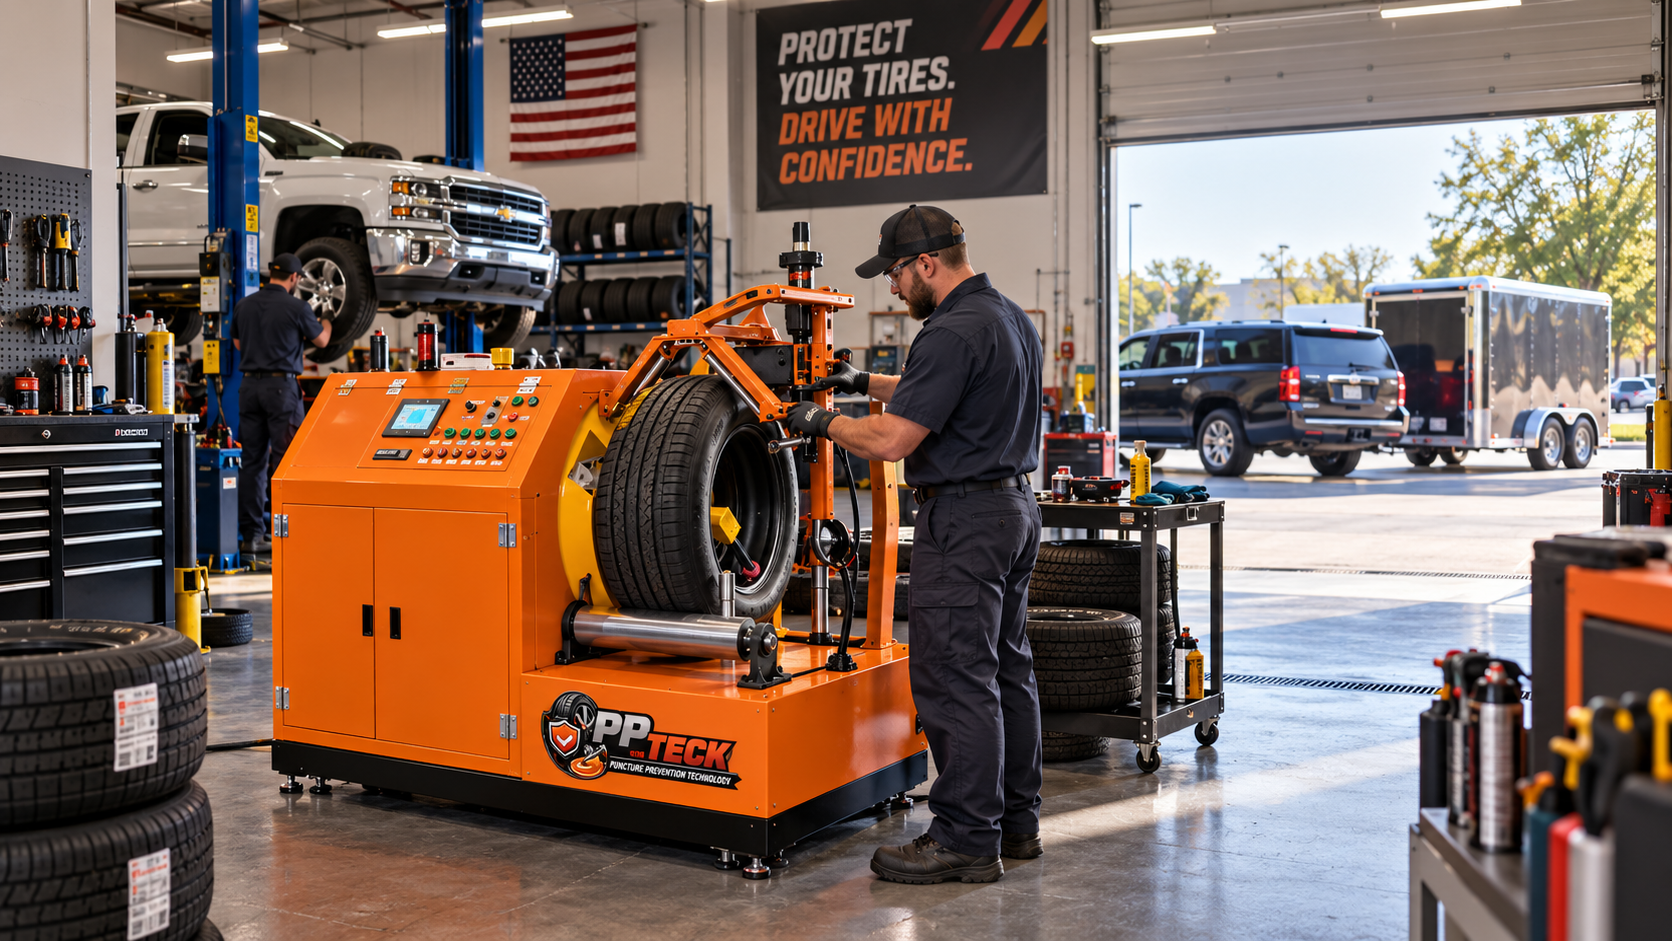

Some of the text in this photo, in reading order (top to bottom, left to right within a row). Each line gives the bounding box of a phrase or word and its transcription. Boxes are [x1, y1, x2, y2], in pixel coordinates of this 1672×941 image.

[778, 18, 913, 66] PROTECT
[779, 55, 955, 105] YOUR TIRES.
[778, 97, 953, 145] DRIVE WITH
[779, 137, 973, 185] CONFIDENCE.
[592, 710, 733, 771] PP TECK
[609, 760, 645, 773] PUNCTURE
[645, 765, 687, 779] PREVENTION
